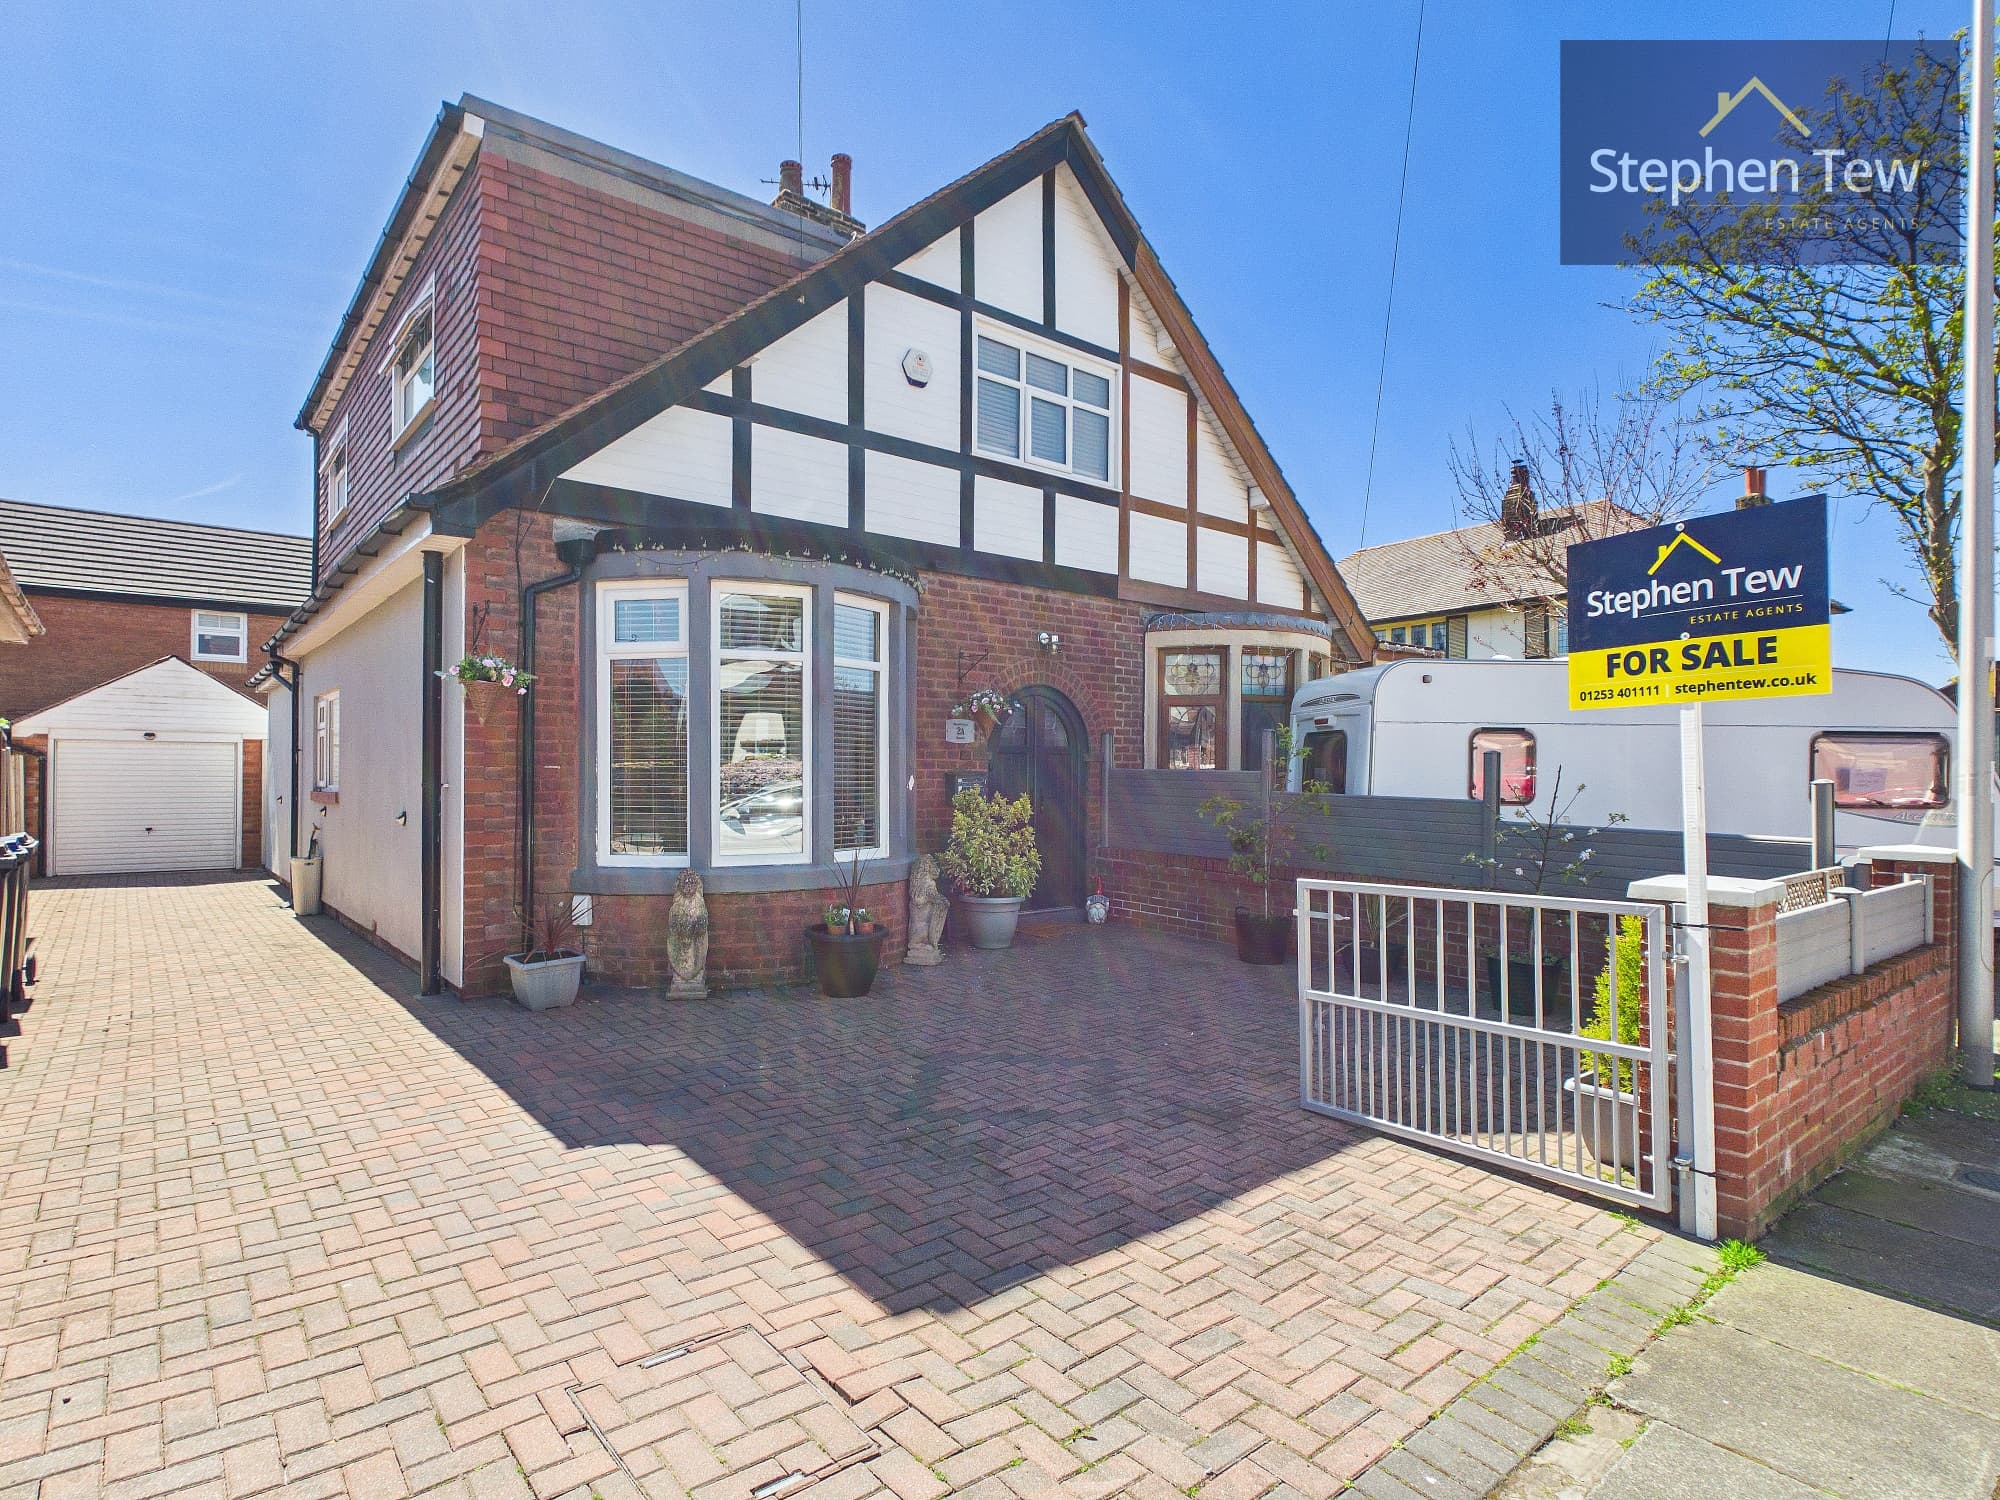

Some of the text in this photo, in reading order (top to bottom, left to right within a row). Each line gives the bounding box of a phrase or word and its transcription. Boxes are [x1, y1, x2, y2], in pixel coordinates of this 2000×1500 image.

[1587, 564, 1803, 618] Stephen Tew
[1689, 603, 1804, 625] ESTATE AGENTS
[1606, 635, 1779, 679] FOR SALE
[1579, 673, 1817, 702] 01253 401111 stephentew.co.uk
